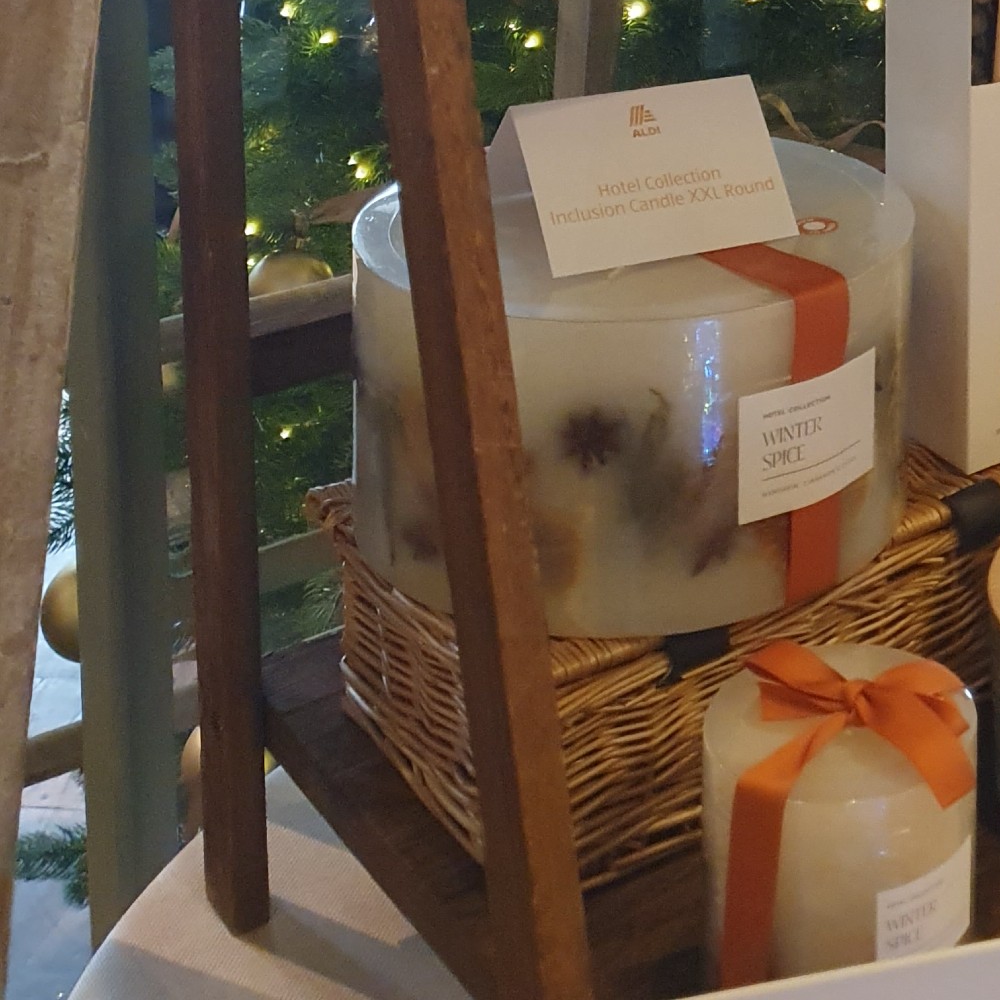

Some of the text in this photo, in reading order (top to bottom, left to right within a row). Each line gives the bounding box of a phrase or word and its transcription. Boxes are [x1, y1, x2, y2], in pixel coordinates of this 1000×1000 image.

[632, 126, 661, 138] ALDI
[598, 167, 721, 197] Hotel Collection
[550, 176, 776, 226] Inclusion Candle XXL Round
[762, 416, 823, 448] WINTER
[762, 443, 806, 472] SPICE
